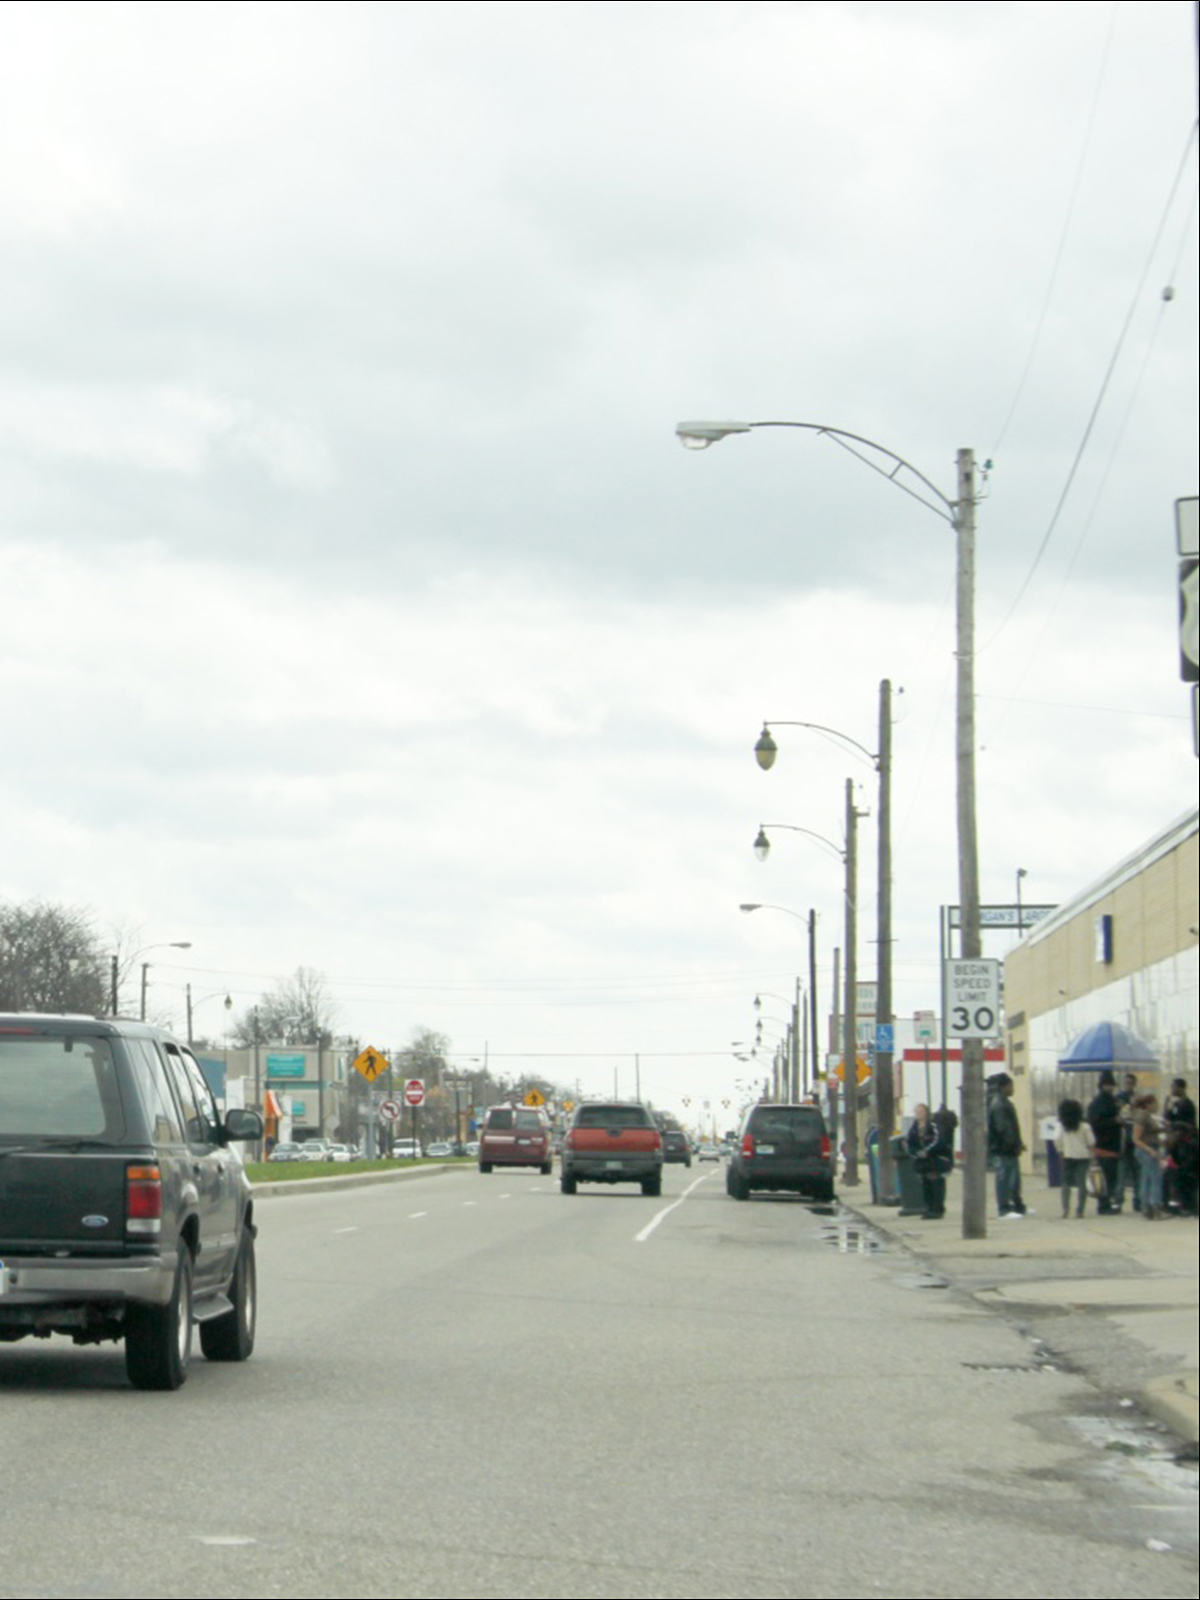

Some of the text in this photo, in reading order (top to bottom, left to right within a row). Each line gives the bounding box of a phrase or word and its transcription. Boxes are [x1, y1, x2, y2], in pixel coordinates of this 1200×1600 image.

[954, 964, 989, 975] BEGIN
[953, 978, 991, 989] SPEED
[957, 991, 987, 1002] LIMIT
[951, 1006, 994, 1031] 30
